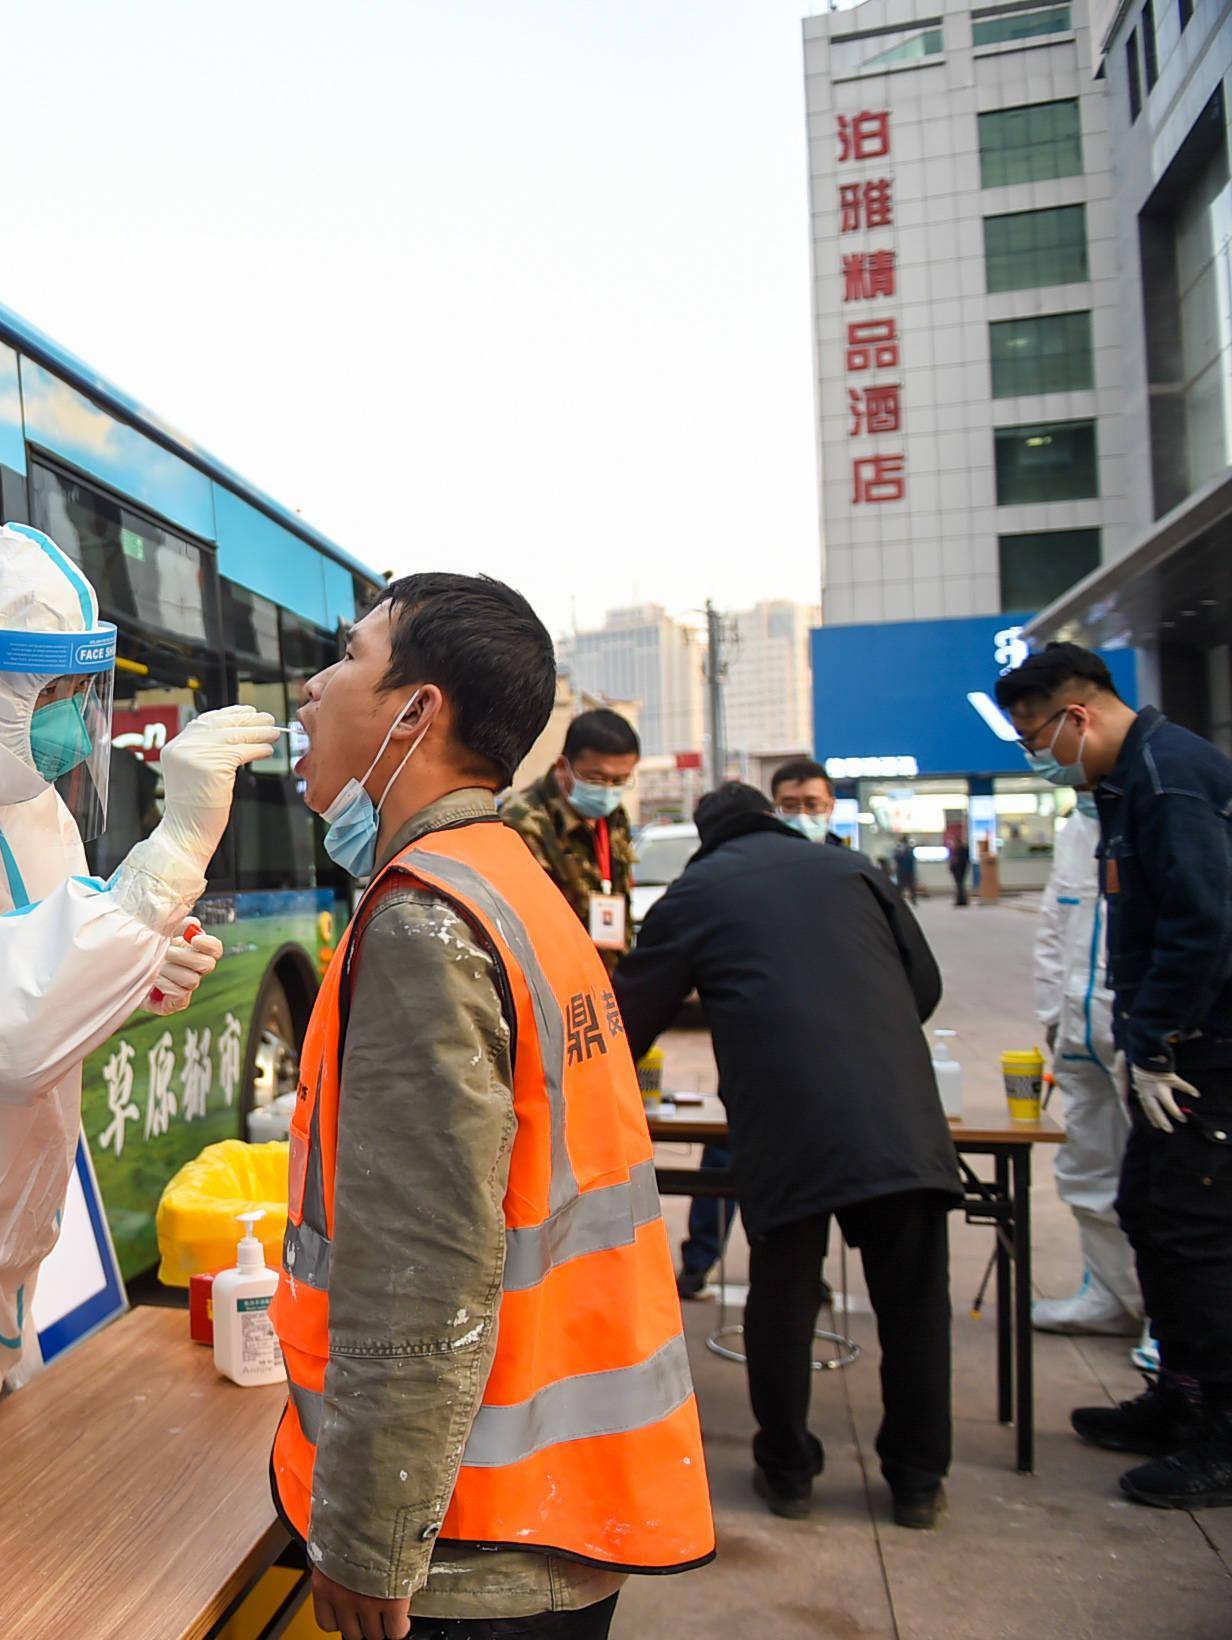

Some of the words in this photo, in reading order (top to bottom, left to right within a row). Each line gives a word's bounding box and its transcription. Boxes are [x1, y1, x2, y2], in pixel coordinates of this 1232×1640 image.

[836, 109, 907, 505] 泊雅精品酒店
[79, 647, 105, 661] FACE
